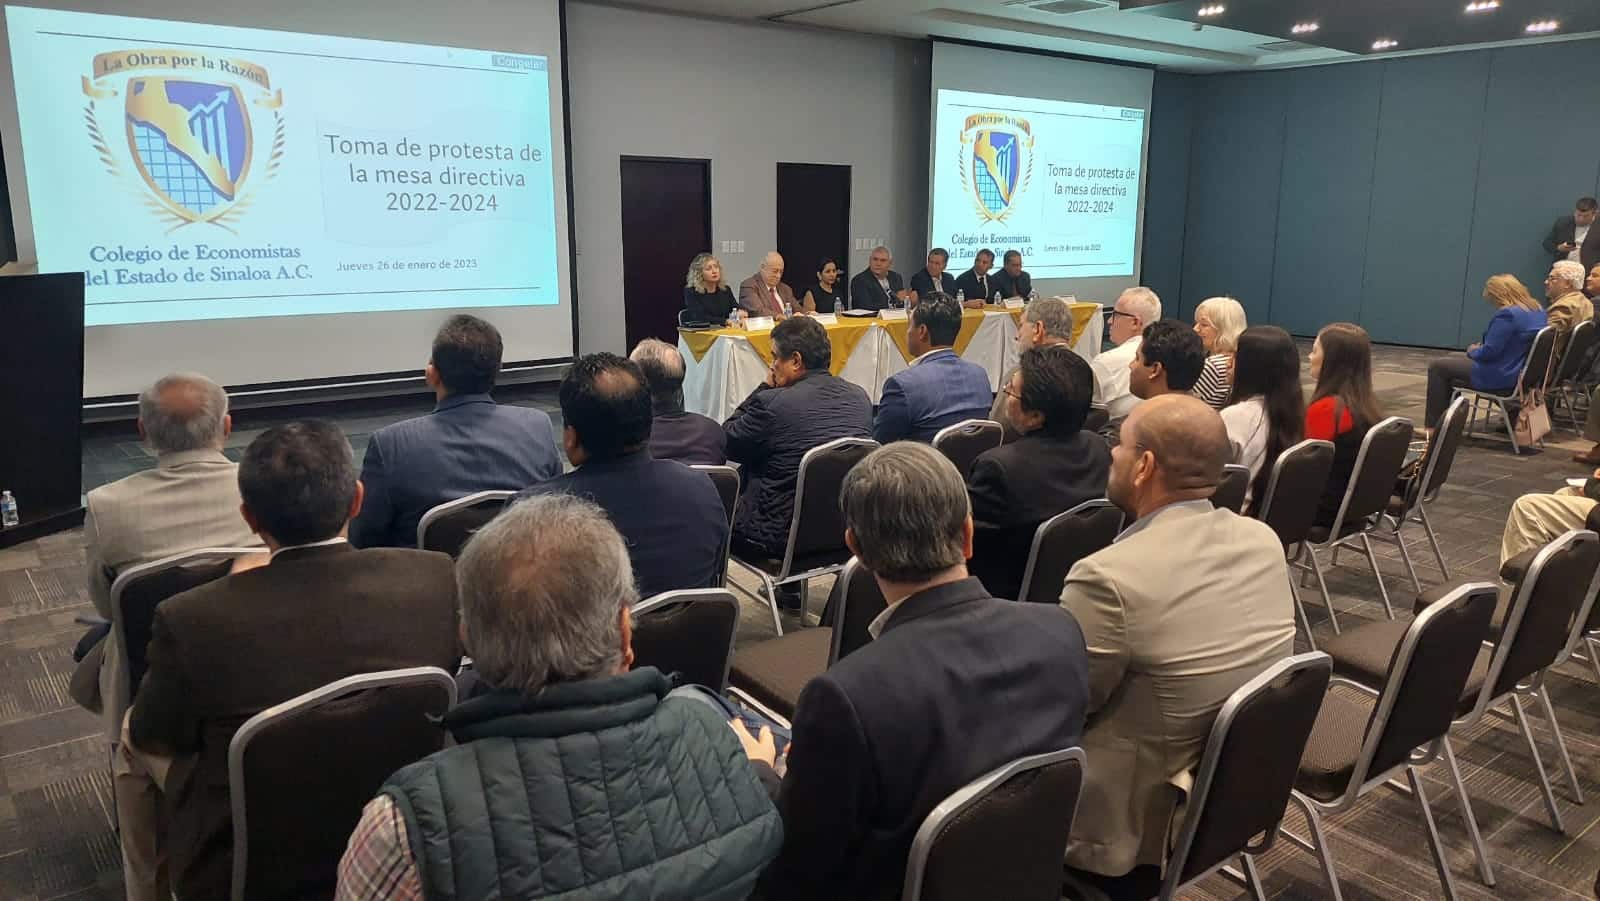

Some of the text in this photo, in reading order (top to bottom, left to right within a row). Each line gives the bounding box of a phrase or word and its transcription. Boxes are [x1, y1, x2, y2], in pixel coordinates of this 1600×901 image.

[103, 52, 264, 84] La Obra por la Razón
[324, 134, 542, 162] Toma de protesta de
[349, 163, 526, 187] la mesa directiva
[1047, 163, 1136, 180] Toma de protesta de
[1054, 181, 1127, 197] la mesa directiva
[386, 192, 499, 212] 2022-2024
[1067, 200, 1115, 213] 2022-2024
[951, 233, 1032, 246] Colegio de Economistas
[89, 243, 301, 265] Colegio de Economistas
[114, 267, 179, 286] Estado
[184, 266, 206, 283] de
[210, 265, 272, 281] Sinaloa
[276, 263, 314, 280] A.C.
[336, 258, 478, 272] Jueves 26 de enero de 2023
